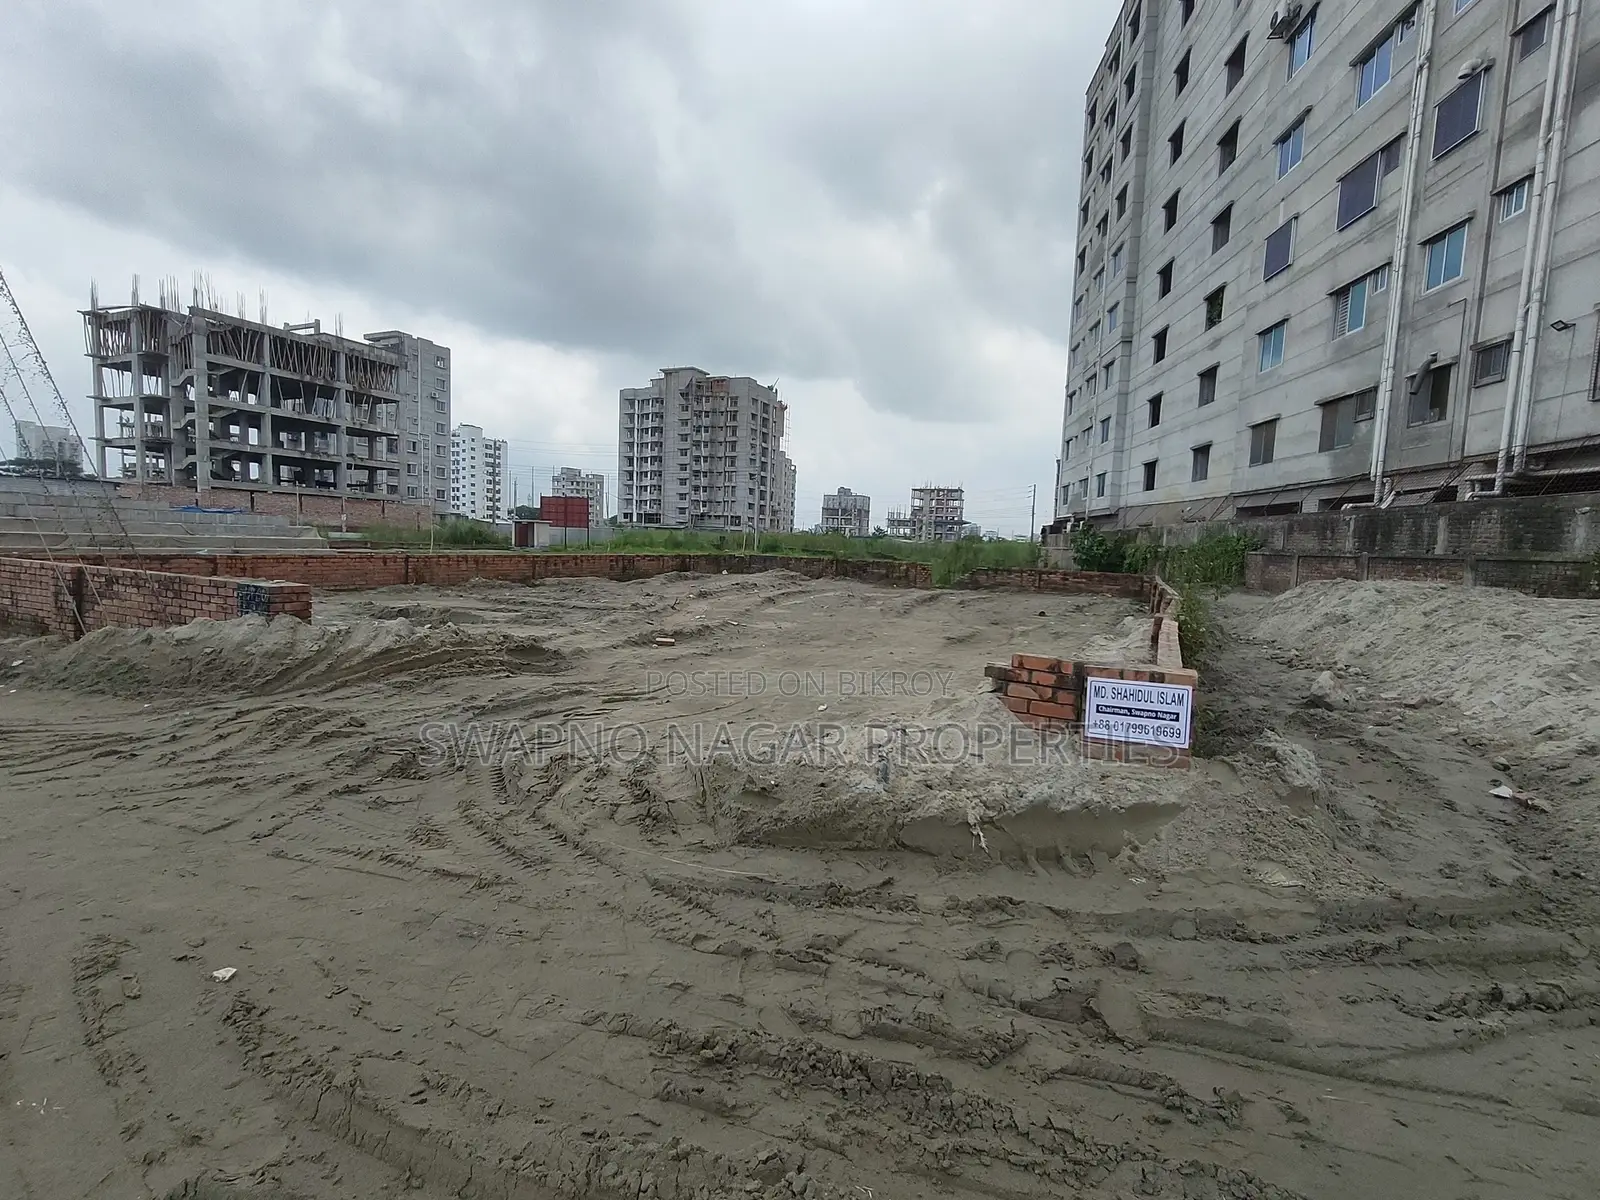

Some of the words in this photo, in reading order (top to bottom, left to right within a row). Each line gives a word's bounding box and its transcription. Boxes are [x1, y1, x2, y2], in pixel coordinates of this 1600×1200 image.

[1093, 685, 1109, 699] MD.
[1111, 687, 1154, 703] SHAHIDUL
[1157, 691, 1184, 706] ISLAM
[1098, 705, 1130, 716] Chairman,
[1131, 708, 1156, 718] Swapno
[1157, 711, 1177, 720] Nagar
[1093, 719, 1110, 731] +88
[1113, 721, 1181, 738] 01799619699
